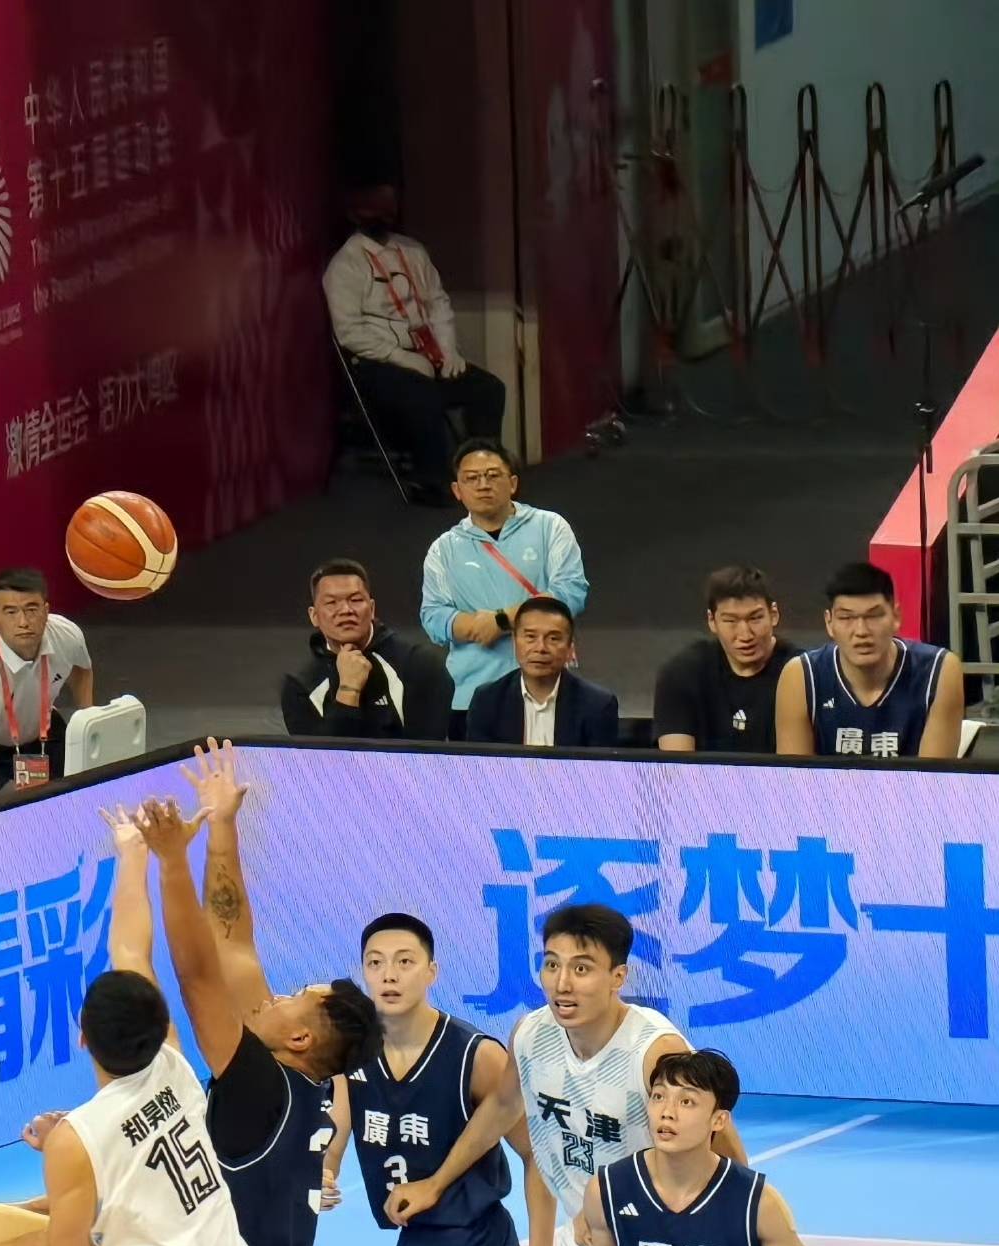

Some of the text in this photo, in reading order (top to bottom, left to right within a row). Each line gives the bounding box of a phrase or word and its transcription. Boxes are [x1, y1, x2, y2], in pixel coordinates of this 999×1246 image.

[835, 717, 898, 757] 廣東
[363, 1110, 430, 1147] 廣東
[537, 1091, 622, 1143] 天津
[145, 1115, 221, 1215] 15
[383, 1155, 409, 1192] 3
[562, 1131, 595, 1176] 23
